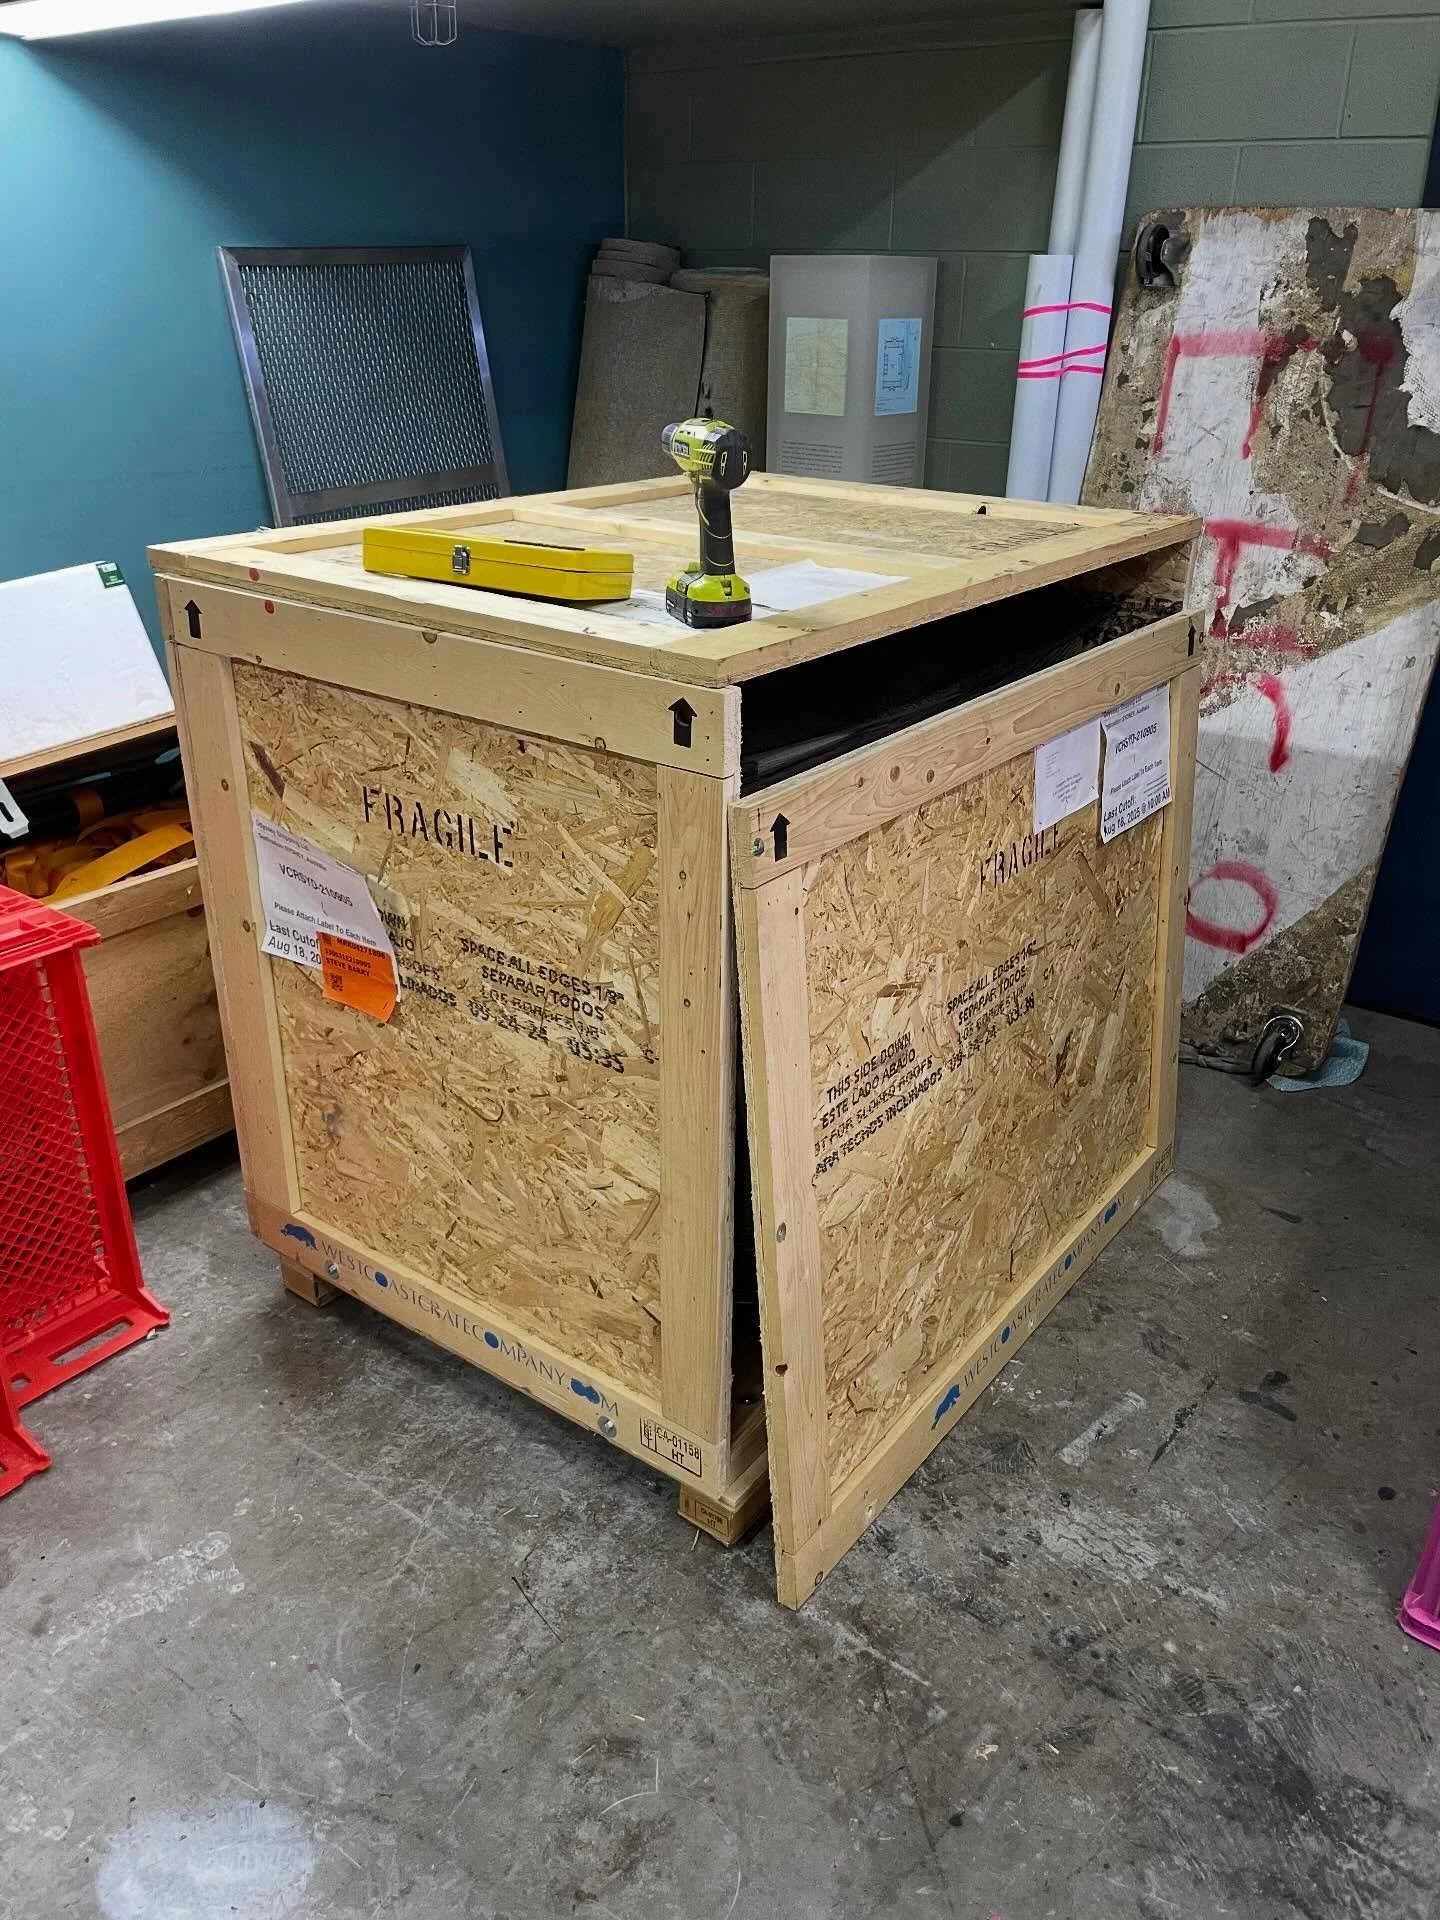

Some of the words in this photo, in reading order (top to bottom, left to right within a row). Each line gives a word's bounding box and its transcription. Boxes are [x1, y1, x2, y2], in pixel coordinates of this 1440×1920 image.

[1144, 763, 1154, 773] Each
[362, 785, 514, 869] FRAGILE
[1103, 806, 1118, 823] Last
[1118, 794, 1137, 816] Cutoff:
[1103, 823, 1116, 838] Aug
[1126, 807, 1141, 824] 2025
[1147, 792, 1162, 811] 10:00
[1161, 787, 1171, 802] AM
[979, 822, 1062, 895] FRAGILE
[269, 919, 290, 941] Last
[292, 929, 320, 950] Cutof
[274, 901, 294, 916] Please
[296, 910, 316, 924] Attach
[317, 917, 335, 931] Label
[335, 924, 344, 934] To
[345, 928, 361, 941] Each
[267, 936, 291, 955] Aug
[294, 945, 309, 961] 18,
[310, 951, 322, 965] 20
[460, 937, 505, 966] SPACE
[507, 955, 534, 976] ALL
[537, 965, 591, 995] EDGES
[481, 965, 546, 1000] SEPARAR
[549, 988, 605, 1021] TODOS
[946, 984, 974, 1016] SPACE
[974, 974, 990, 993] ALL
[991, 951, 1021, 983] EDGES
[958, 987, 997, 1026] SEPARAR
[999, 963, 1026, 993] TODOS
[820, 1097, 849, 1130] ESTE
[851, 1074, 880, 1106] LADO
[882, 1048, 917, 1083] ABAJO
[826, 1075, 851, 1104] THIS
[854, 1055, 878, 1084] SIDE
[880, 1031, 912, 1064] DOWN
[656, 1425, 700, 1460] CA-01158
[671, 1448, 685, 1465] HT
